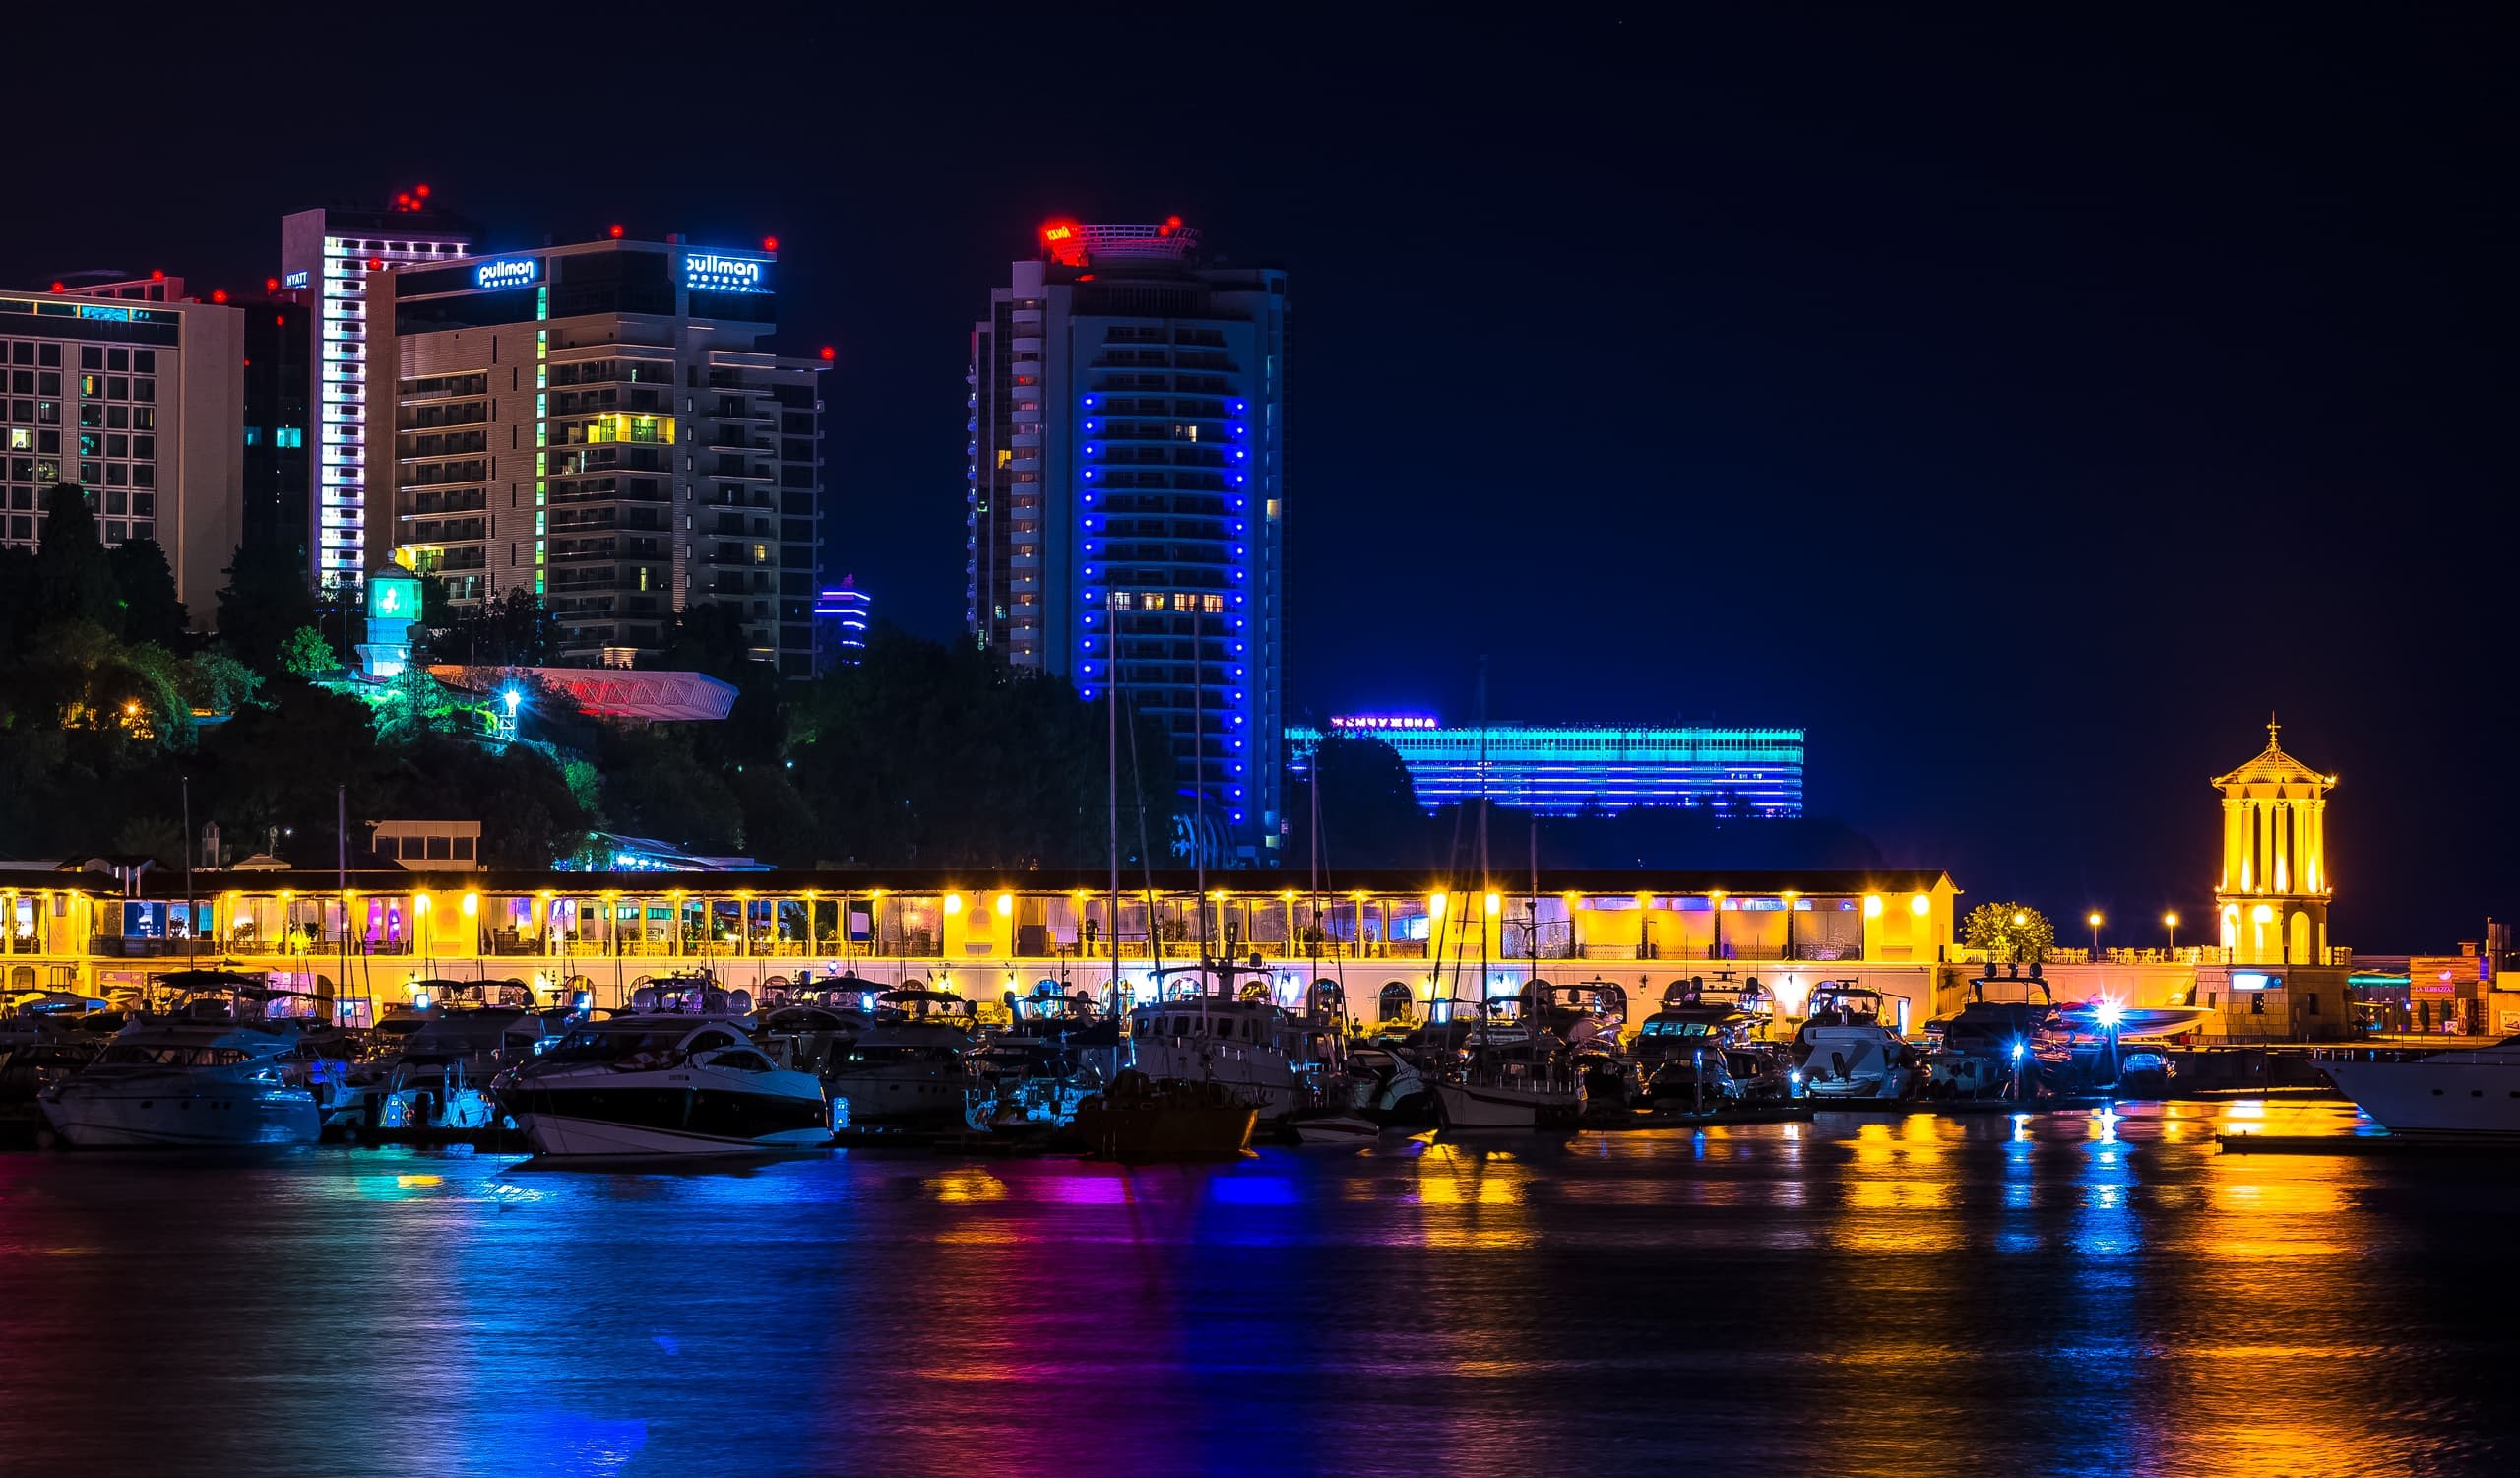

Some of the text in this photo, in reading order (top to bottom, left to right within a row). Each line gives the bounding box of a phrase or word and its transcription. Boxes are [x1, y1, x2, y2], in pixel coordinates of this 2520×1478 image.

[286, 271, 308, 287] HYATT
[479, 260, 534, 286] pullman
[689, 273, 751, 285] HOTELS
[484, 276, 529, 288] HOTELS
